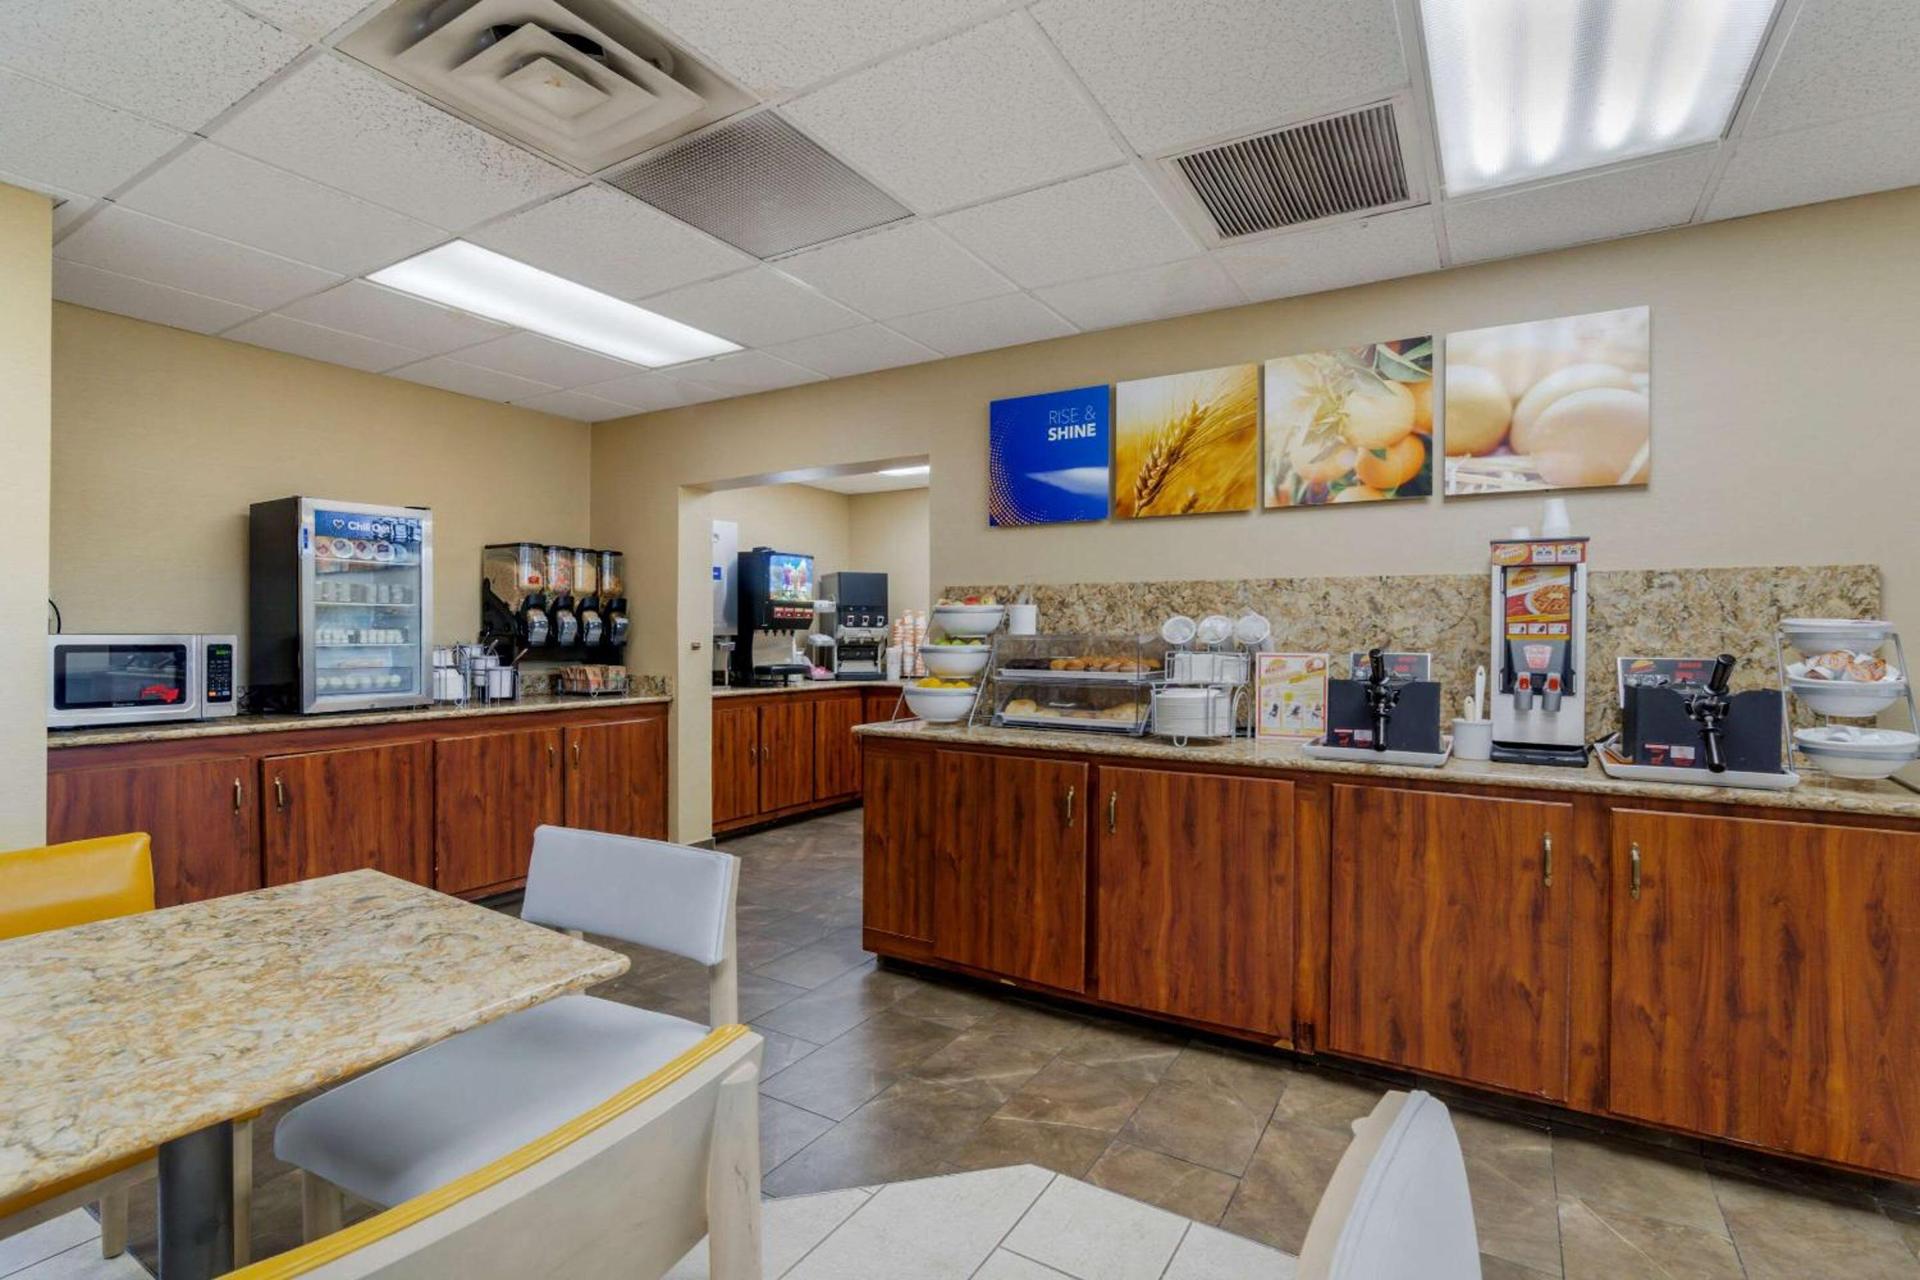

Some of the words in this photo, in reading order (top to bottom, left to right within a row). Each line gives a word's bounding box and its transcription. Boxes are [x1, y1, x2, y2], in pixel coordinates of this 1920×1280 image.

[1049, 407, 1079, 424] RISE
[1084, 404, 1096, 421] &
[1048, 423, 1096, 441] SHINE
